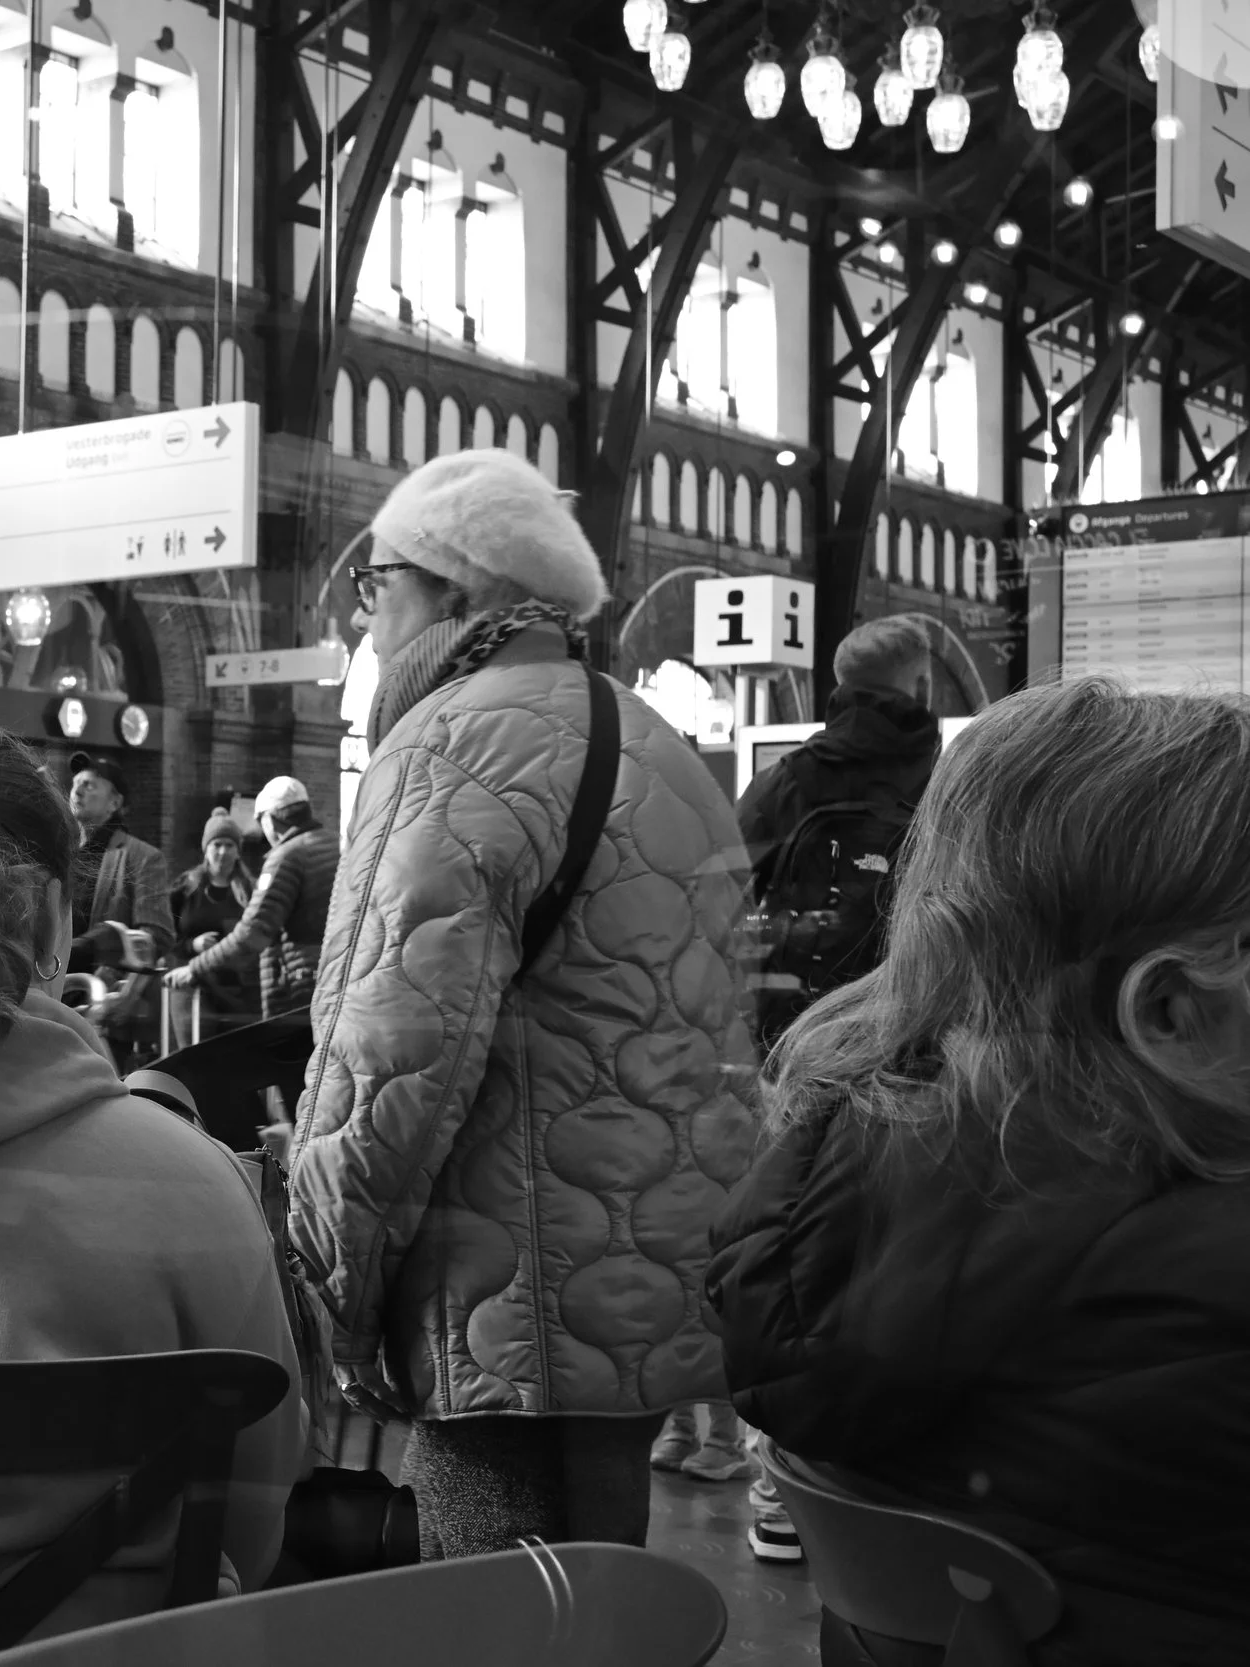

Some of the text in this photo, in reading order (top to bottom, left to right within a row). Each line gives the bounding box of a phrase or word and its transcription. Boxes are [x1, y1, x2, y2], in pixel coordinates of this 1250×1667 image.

[65, 453, 109, 469] Udgang
[1134, 510, 1190, 524] Departures
[716, 589, 753, 647] i
[783, 591, 803, 649] i
